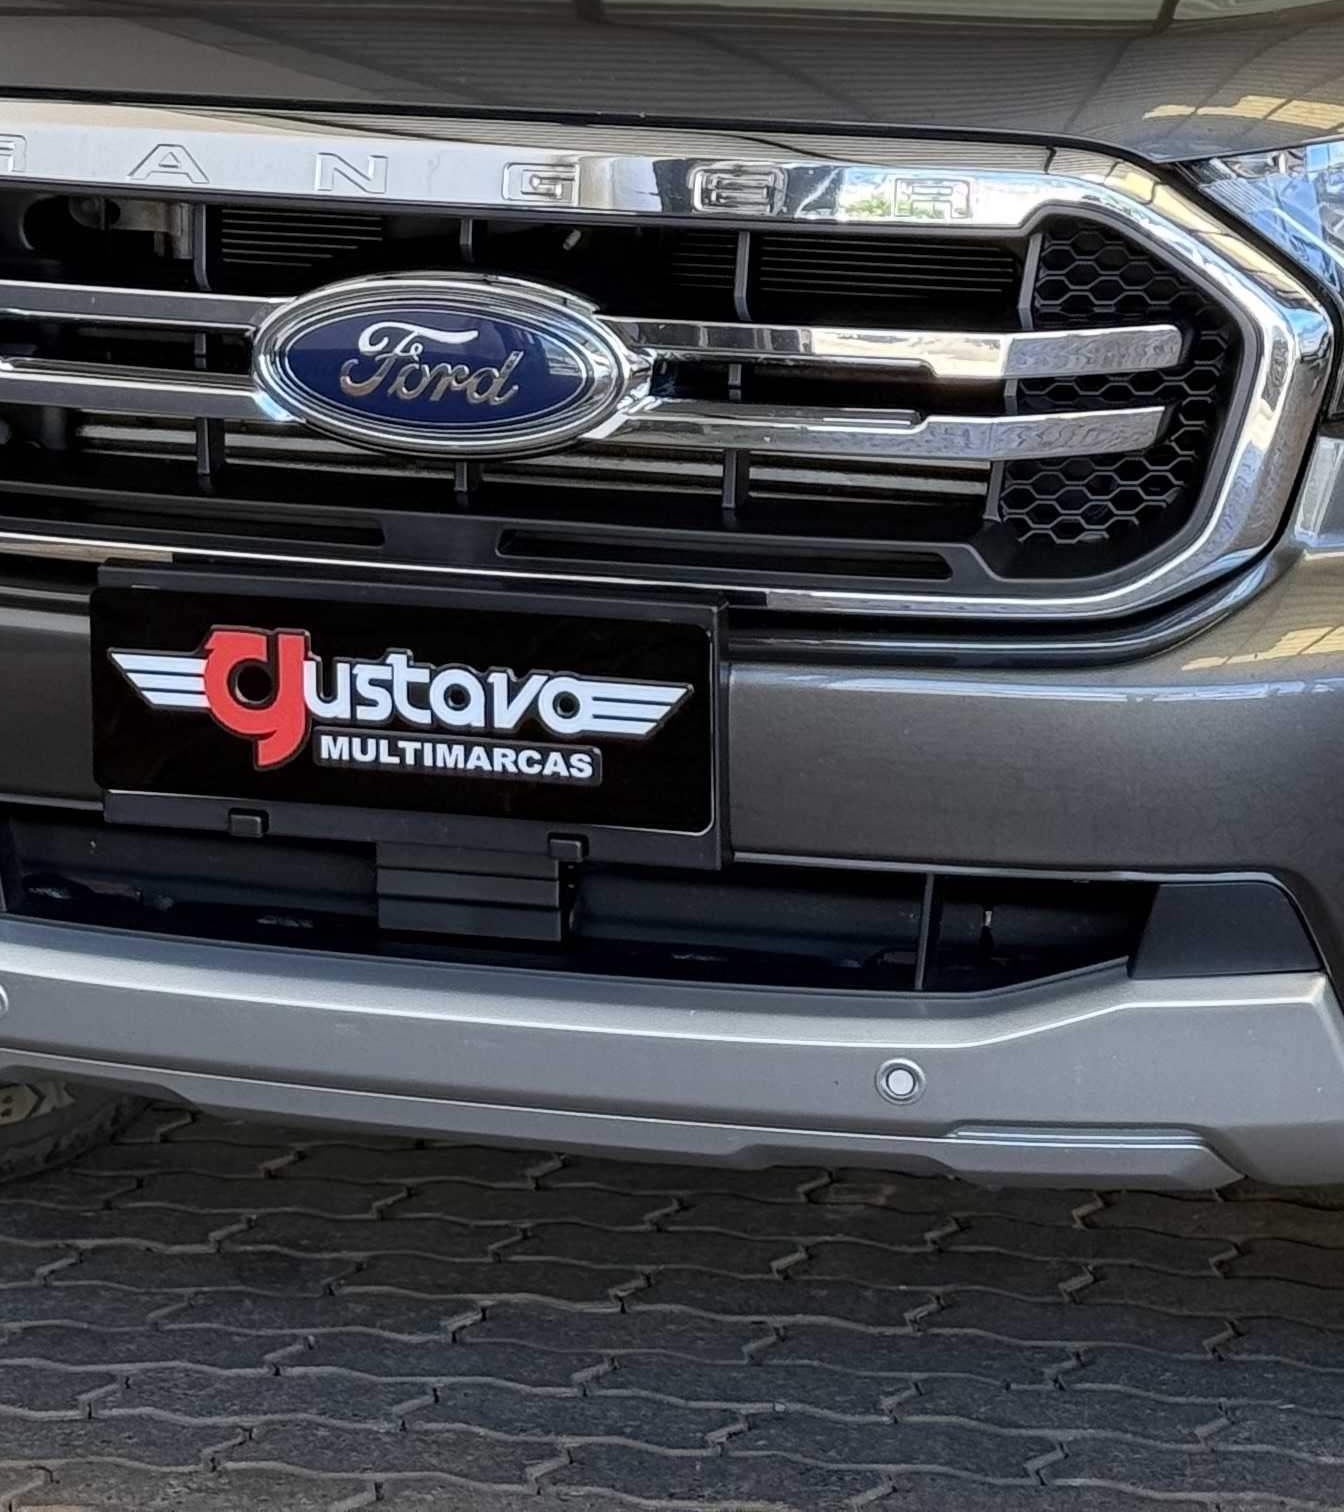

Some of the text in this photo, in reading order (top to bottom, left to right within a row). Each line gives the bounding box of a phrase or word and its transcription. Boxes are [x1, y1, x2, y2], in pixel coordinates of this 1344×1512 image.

[339, 321, 525, 406] Ford
[202, 628, 594, 768] gustavo
[319, 733, 594, 779] MULTIMARCAS
